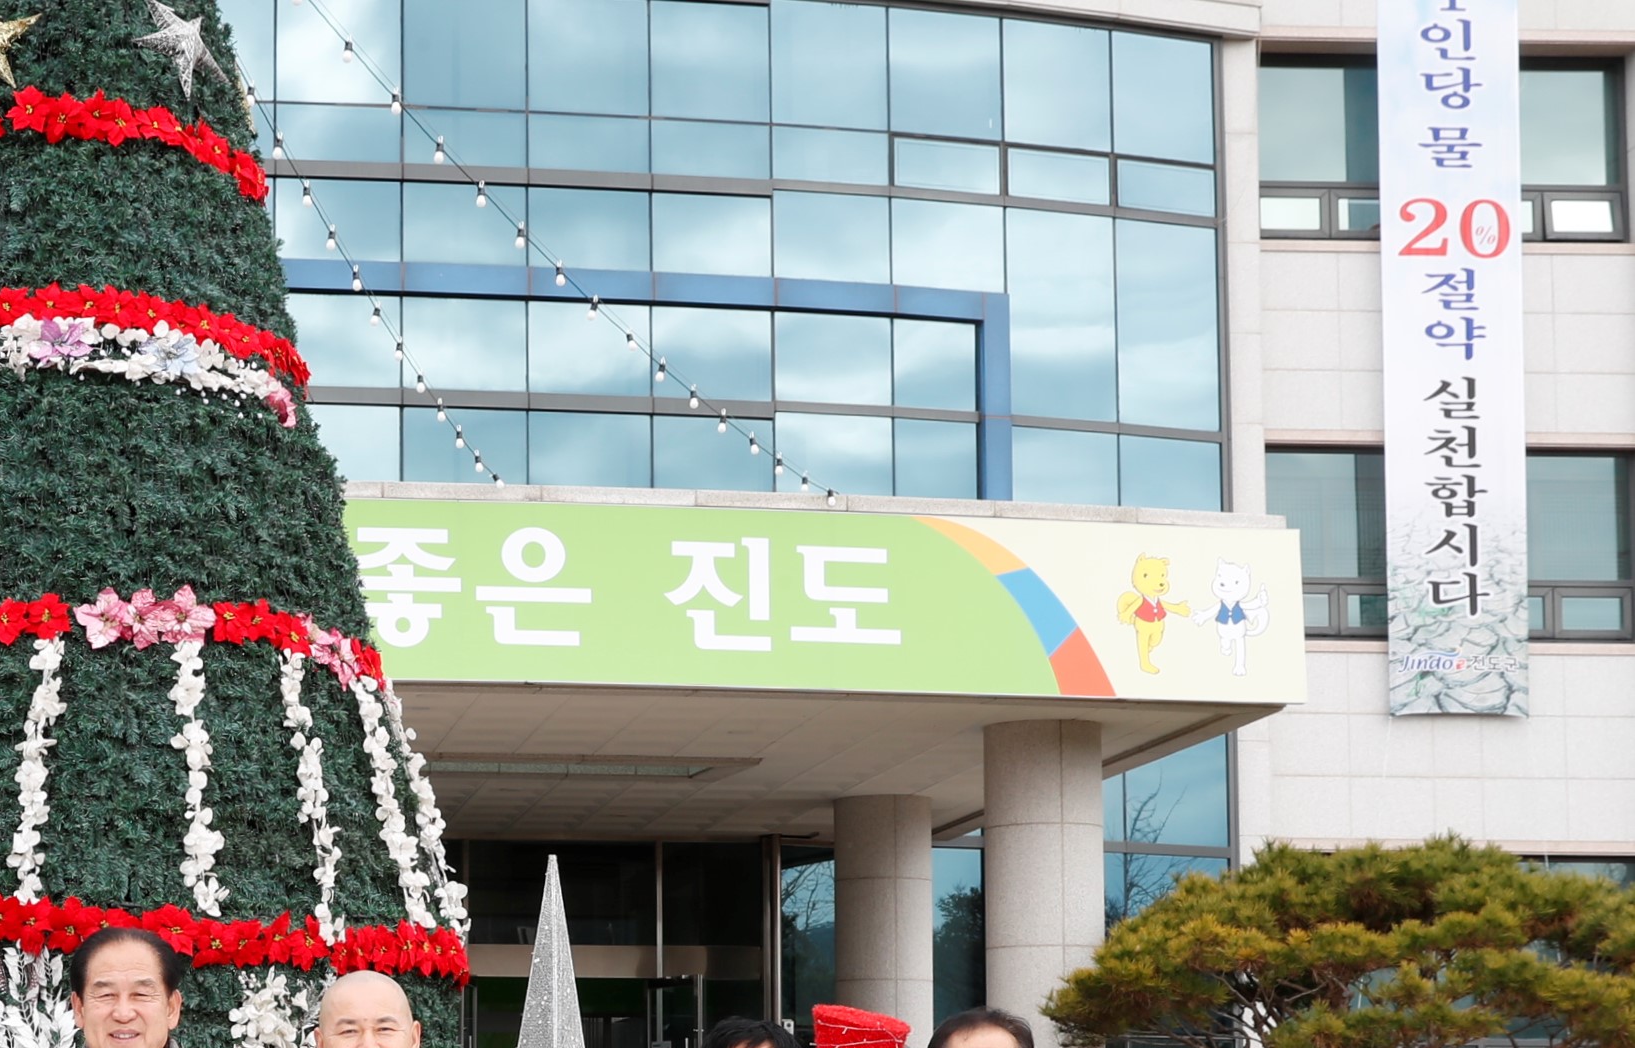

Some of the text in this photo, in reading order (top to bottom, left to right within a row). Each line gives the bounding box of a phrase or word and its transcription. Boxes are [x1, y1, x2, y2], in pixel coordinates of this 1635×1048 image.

[1420, 0, 1483, 109] 인당
[1418, 127, 1483, 168] 물
[1421, 268, 1487, 360] 절약
[1423, 377, 1491, 616] 실천합시다
[357, 527, 592, 647] 좋은
[664, 537, 902, 652] 진도
[1398, 655, 1453, 672] Jindo
